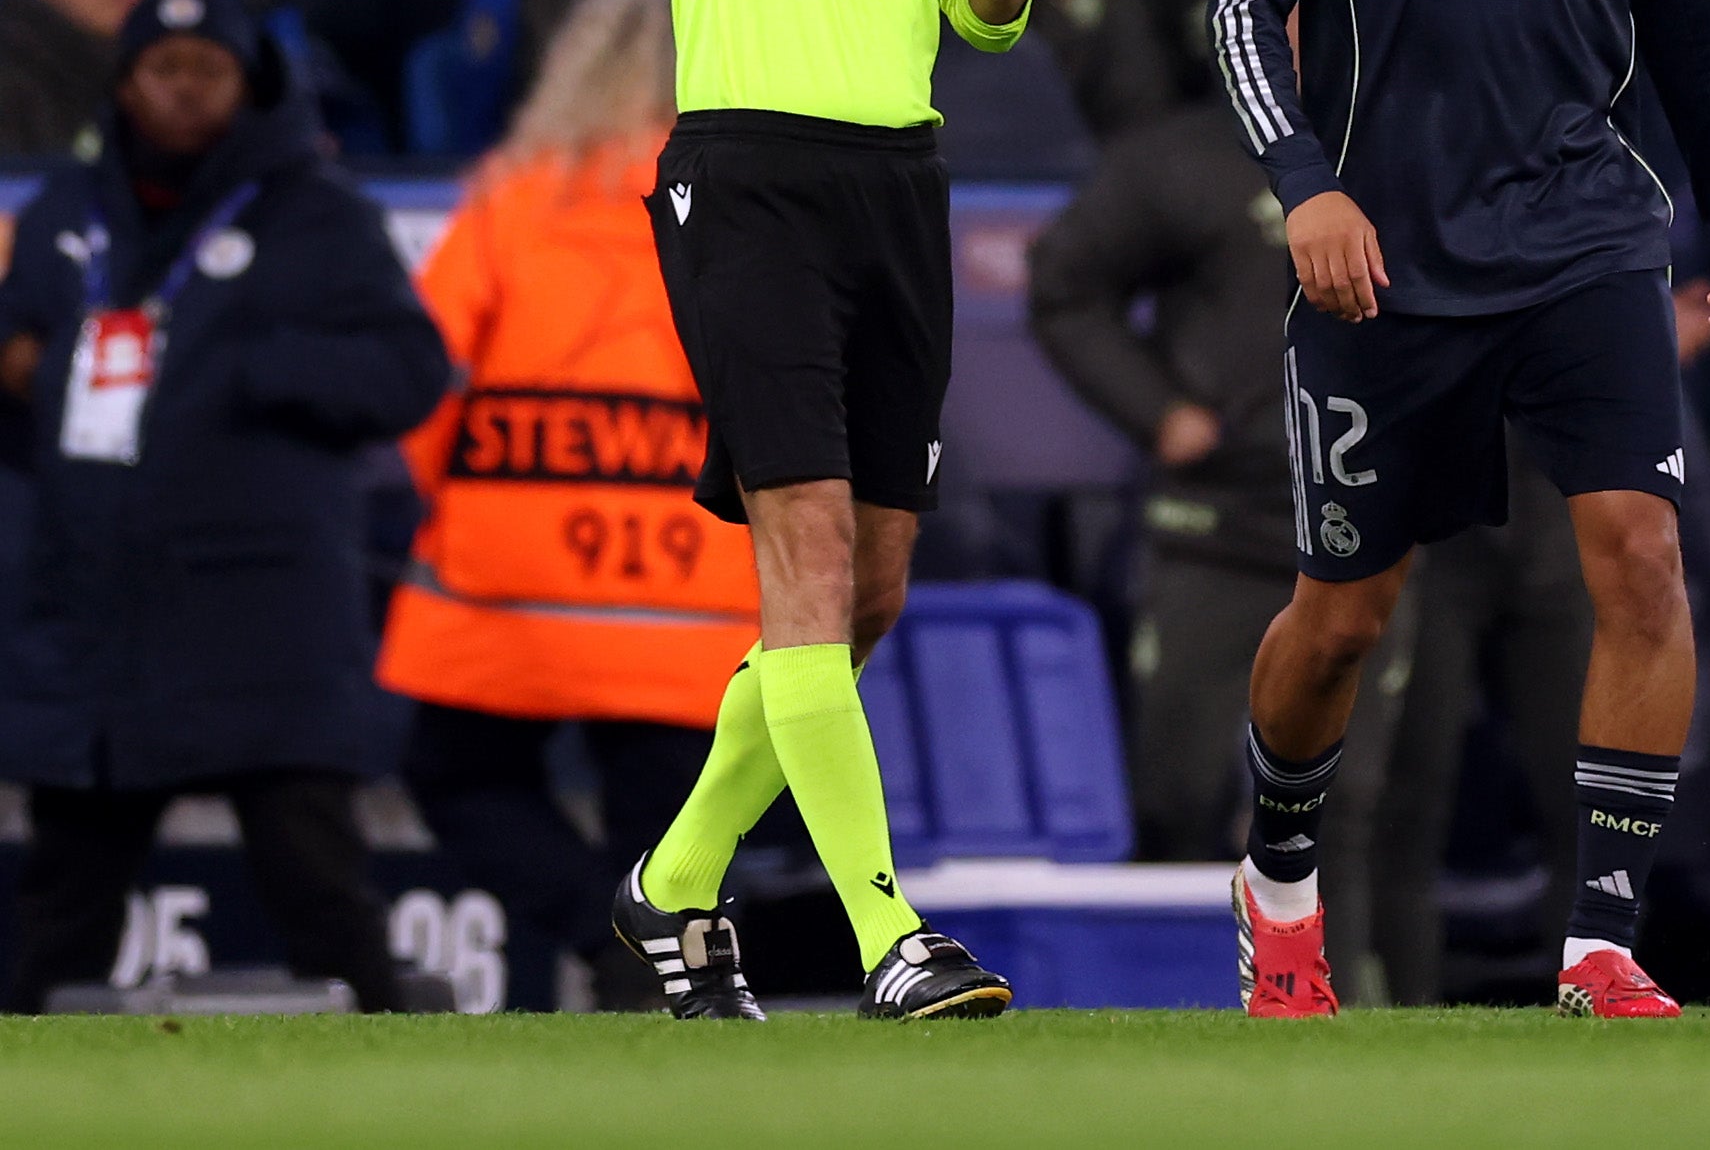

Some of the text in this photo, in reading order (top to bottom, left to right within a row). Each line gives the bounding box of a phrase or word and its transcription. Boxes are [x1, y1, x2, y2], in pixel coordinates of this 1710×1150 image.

[1300, 386, 1378, 487] 12
[562, 510, 705, 578] 919
[1590, 809, 1662, 838] RMCF
